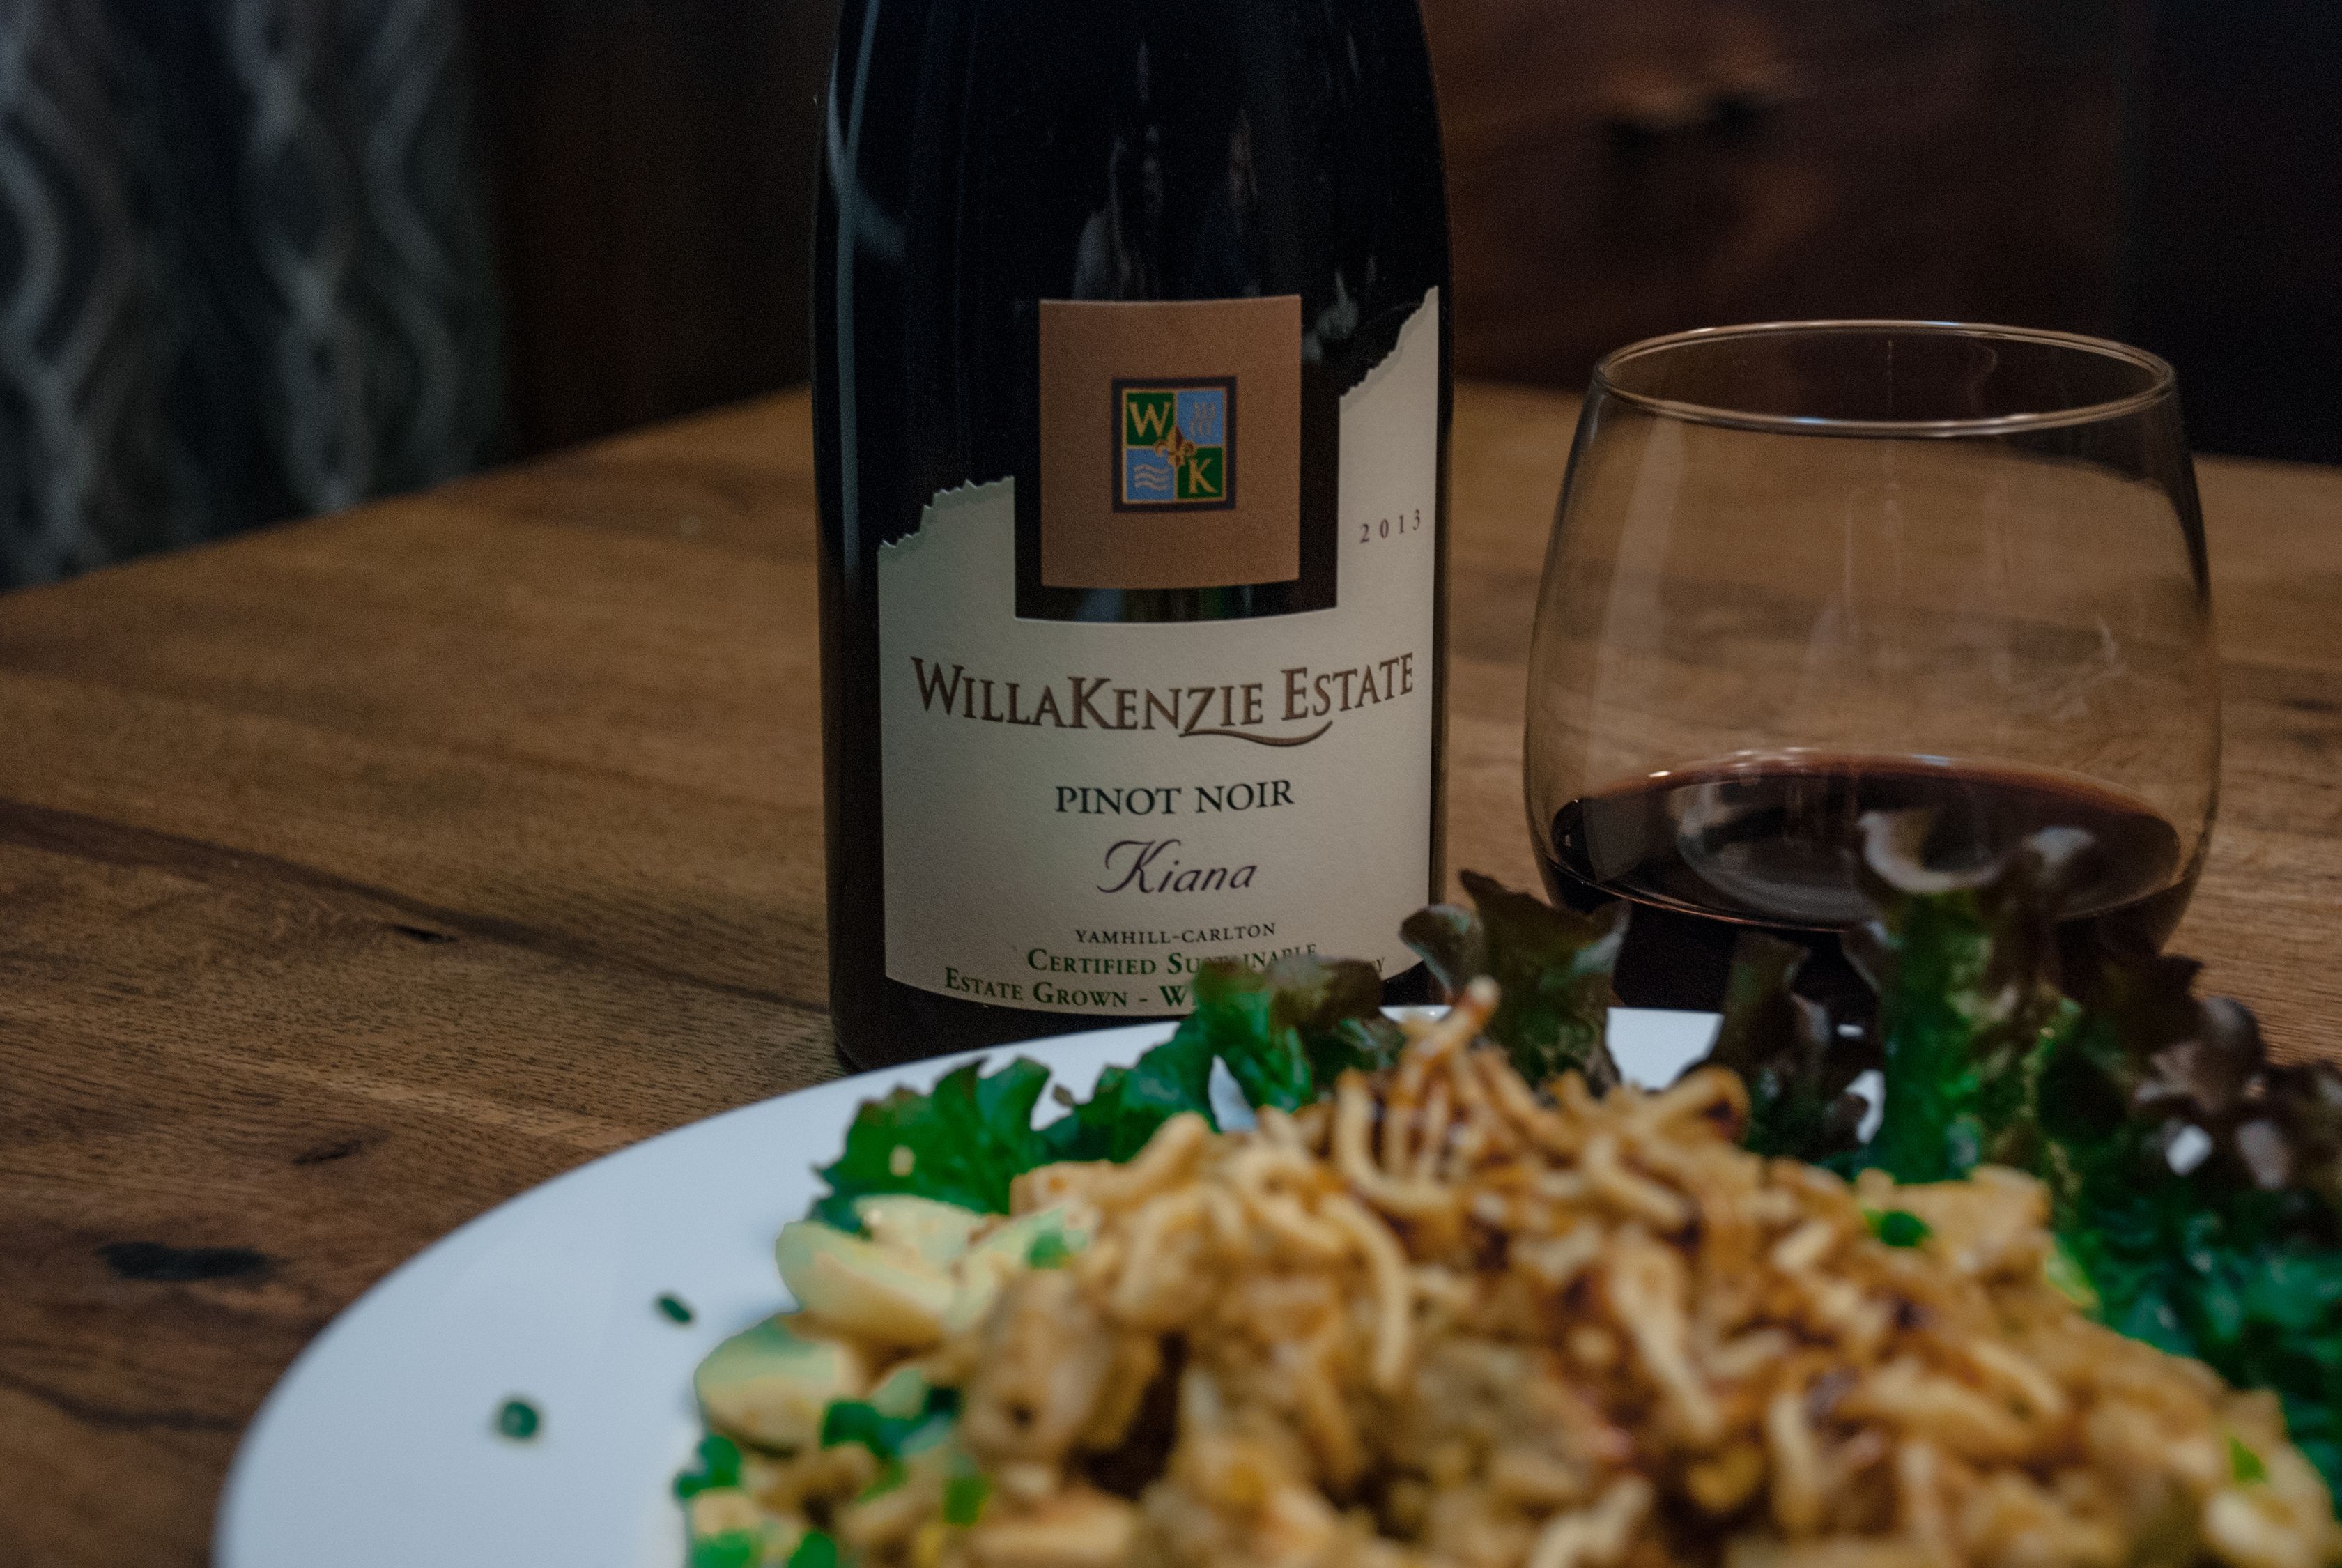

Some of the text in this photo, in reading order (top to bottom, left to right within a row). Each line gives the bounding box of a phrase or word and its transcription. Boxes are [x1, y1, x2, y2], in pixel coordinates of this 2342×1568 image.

[1128, 401, 1171, 438] W
[1188, 457, 1217, 494] K
[1359, 509, 1420, 544] 2013
[1280, 652, 1413, 721] ESTATE
[1055, 779, 1295, 815] PINOT NOIR
[1097, 839, 1258, 894] Kiana
[1075, 922, 1276, 944] YAMHILL-CARLTON
[1027, 948, 1156, 975] CERTIFIED
[945, 967, 1023, 1001] ESTATE
[1033, 981, 1128, 1008] GROWN
